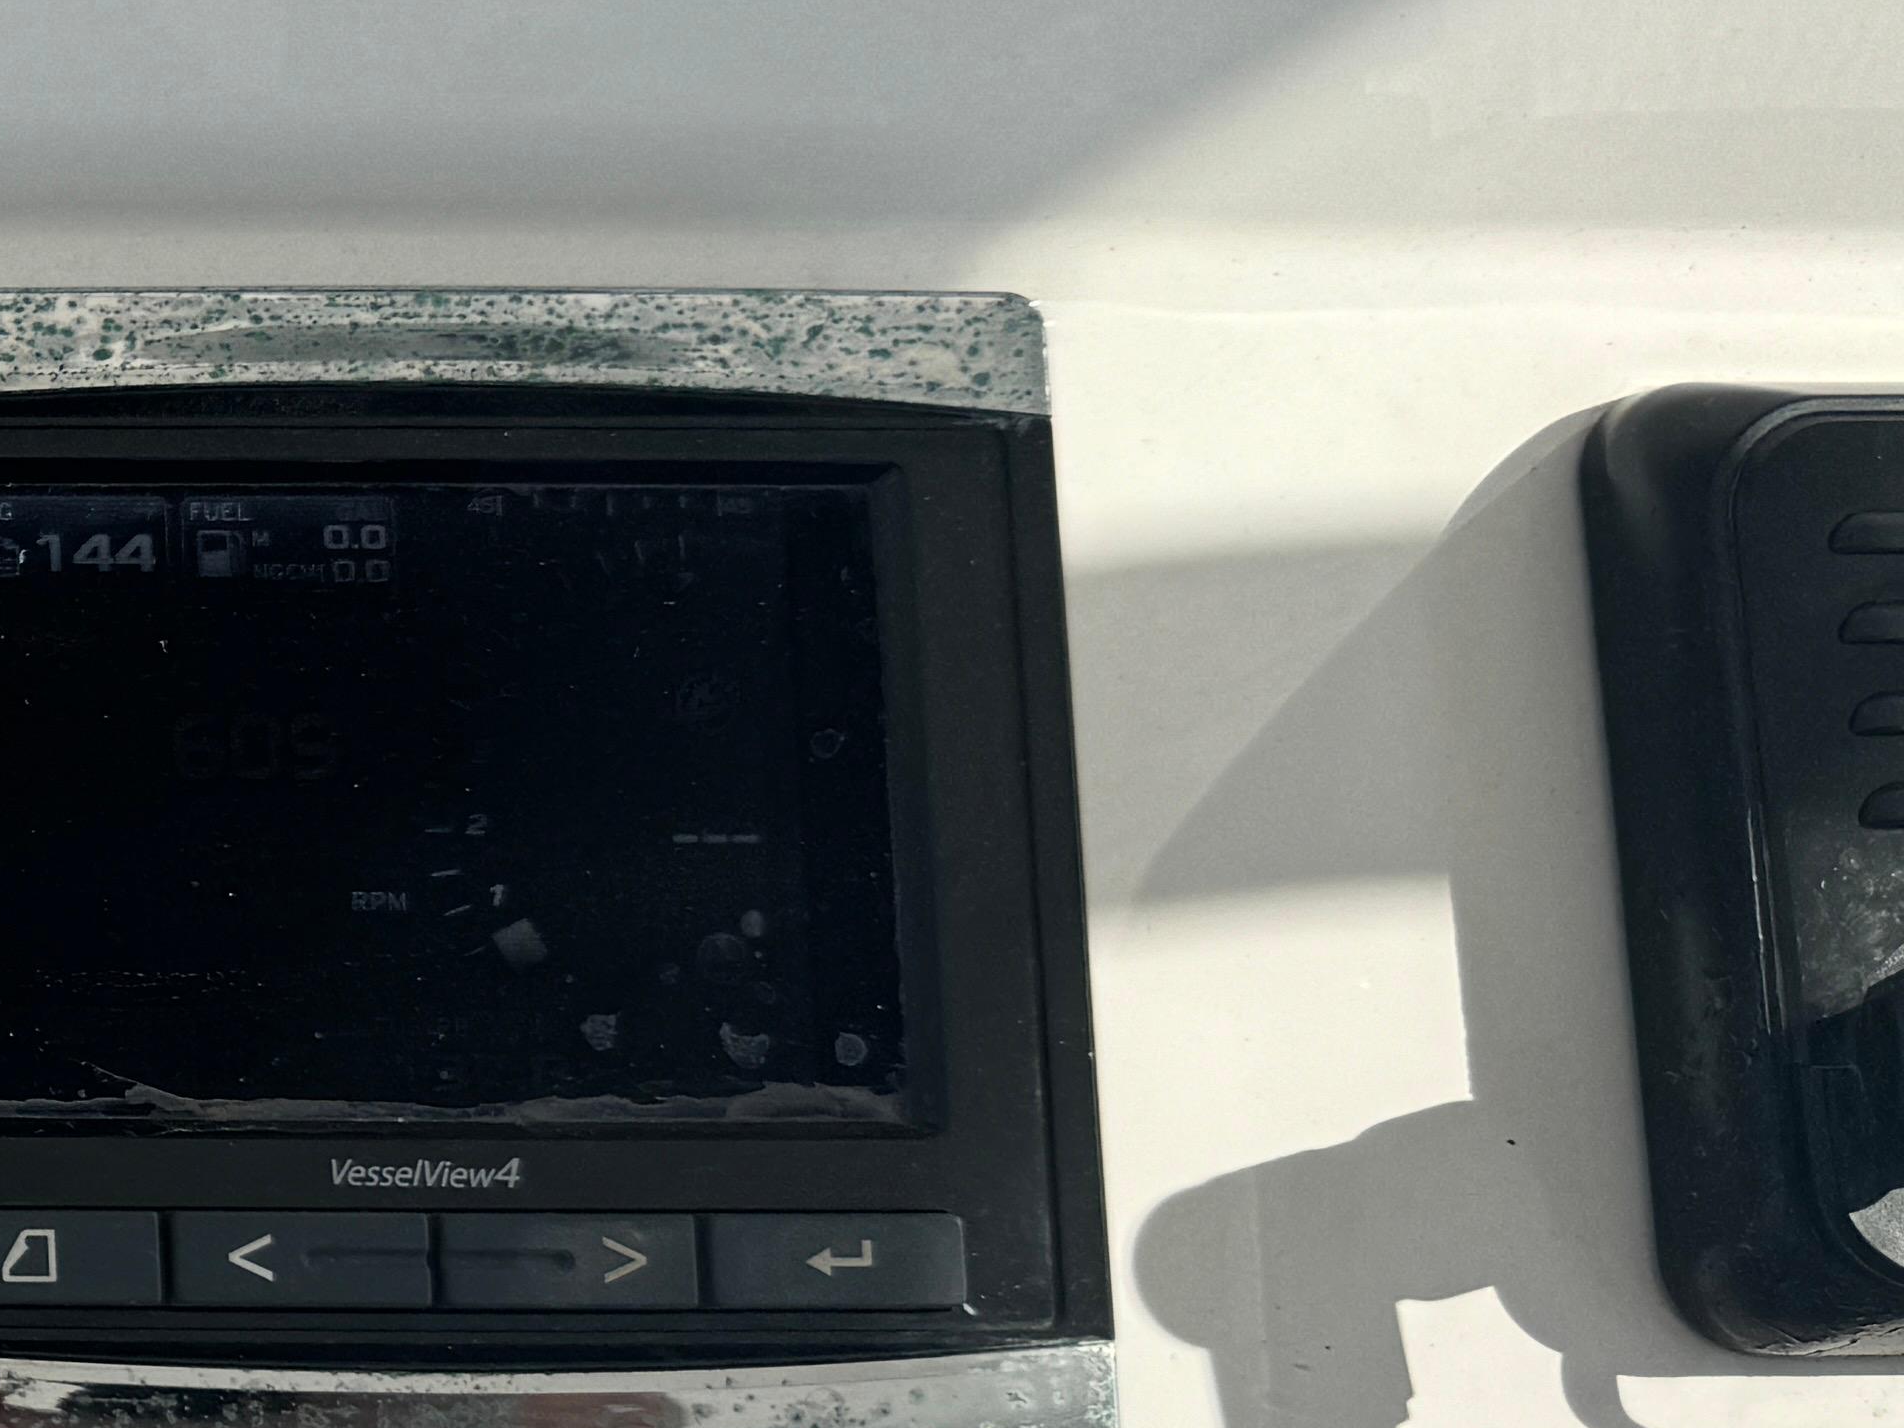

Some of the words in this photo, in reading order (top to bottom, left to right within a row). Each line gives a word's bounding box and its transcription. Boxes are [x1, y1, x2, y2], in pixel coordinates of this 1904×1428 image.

[190, 502, 252, 522] FUEL
[323, 523, 389, 550] 0.0
[37, 533, 156, 573] 144
[350, 889, 409, 913] RPM
[328, 1156, 523, 1192] VesselView4
